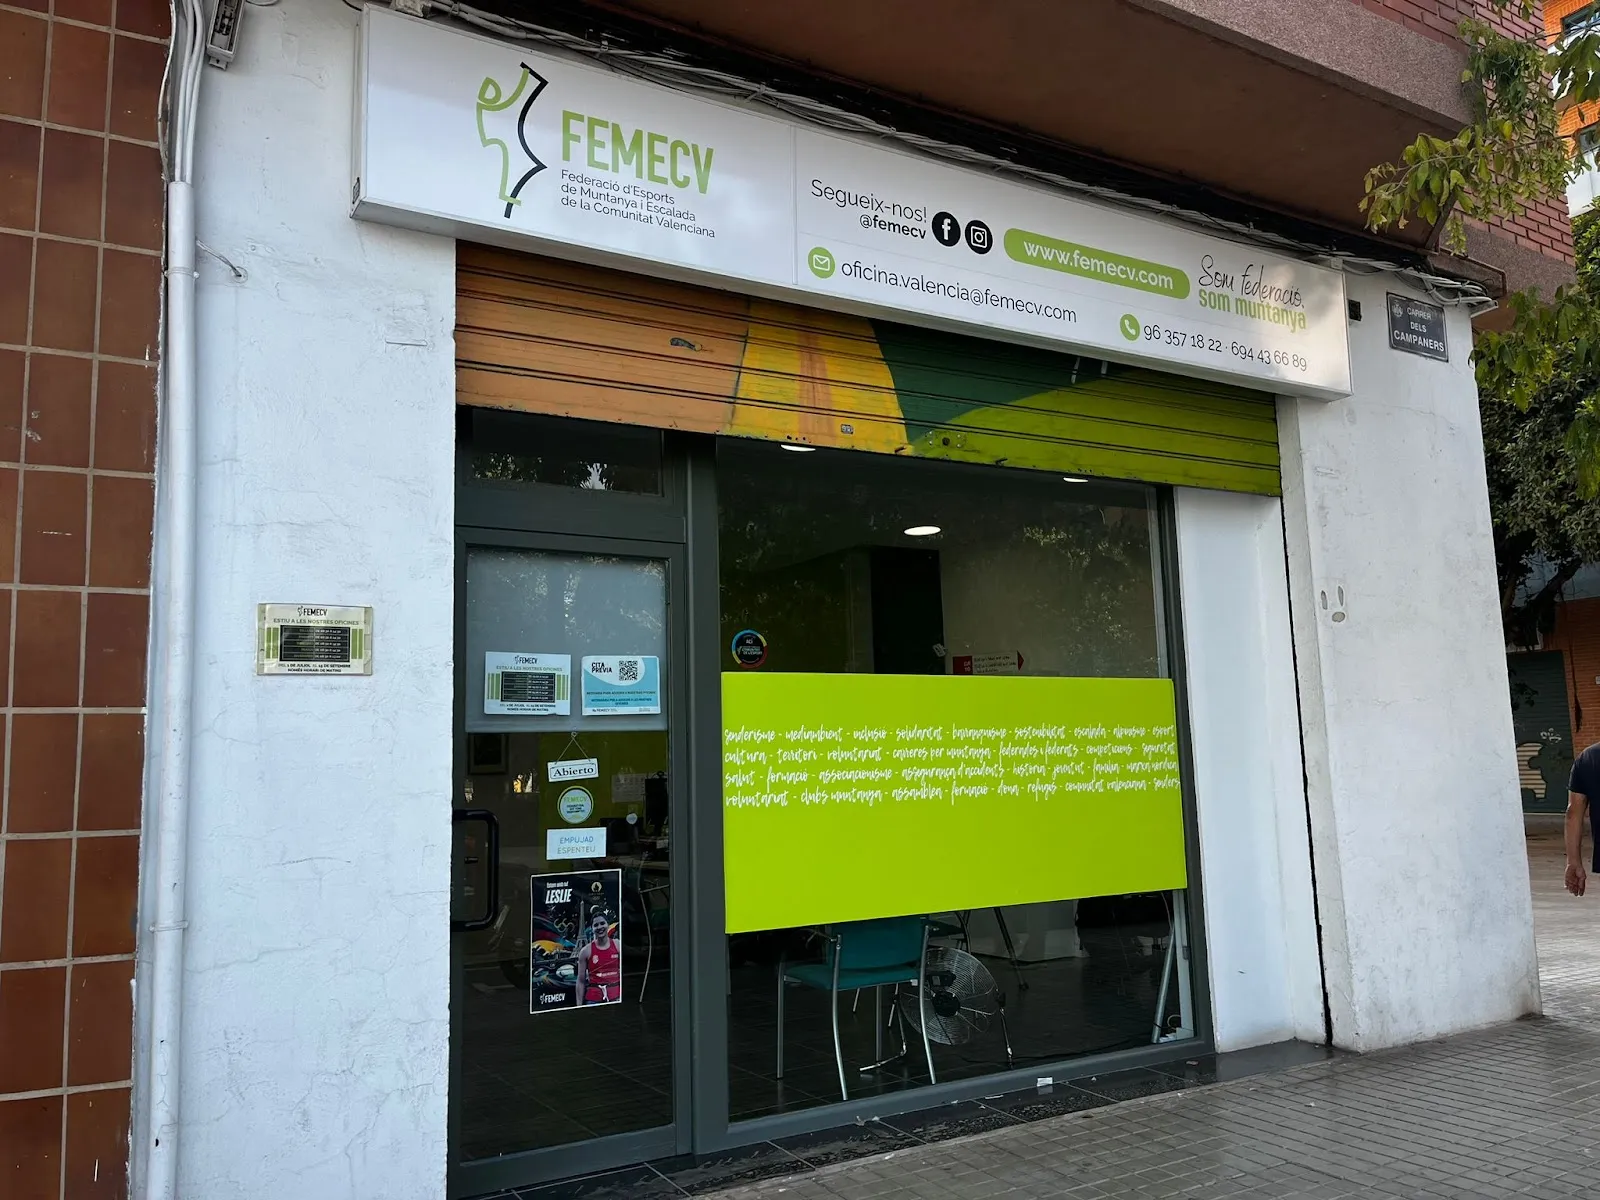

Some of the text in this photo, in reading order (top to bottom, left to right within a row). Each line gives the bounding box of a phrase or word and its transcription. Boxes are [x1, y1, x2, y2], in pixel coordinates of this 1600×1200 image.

[562, 110, 714, 194] FEMECV
[561, 169, 675, 206] Federació d'Esports
[561, 182, 696, 222] de Muntanya i Escalada
[811, 179, 928, 223] Segueix-nos!
[561, 195, 716, 238] de la Comunitat Valenciana
[859, 214, 926, 240] @femecv
[1023, 240, 1174, 291] www.femecv.com
[1199, 254, 1234, 289] Som
[841, 260, 1077, 323] oficina.valencia@femecv.com
[1199, 288, 1307, 334] som muntanya
[1407, 307, 1432, 320] CARRER
[1393, 330, 1445, 352] CAMPANERS
[1410, 321, 1427, 333] DELS
[1144, 324, 1307, 372] 96 357 18 22 694 43 66 89
[303, 608, 328, 617] FEMECV
[553, 767, 594, 777] Abierto
[557, 846, 596, 855] ESPENTEU
[560, 836, 594, 844] EMPUJAD
[545, 888, 572, 904] LESLIE
[545, 993, 566, 1004] FEMECV
